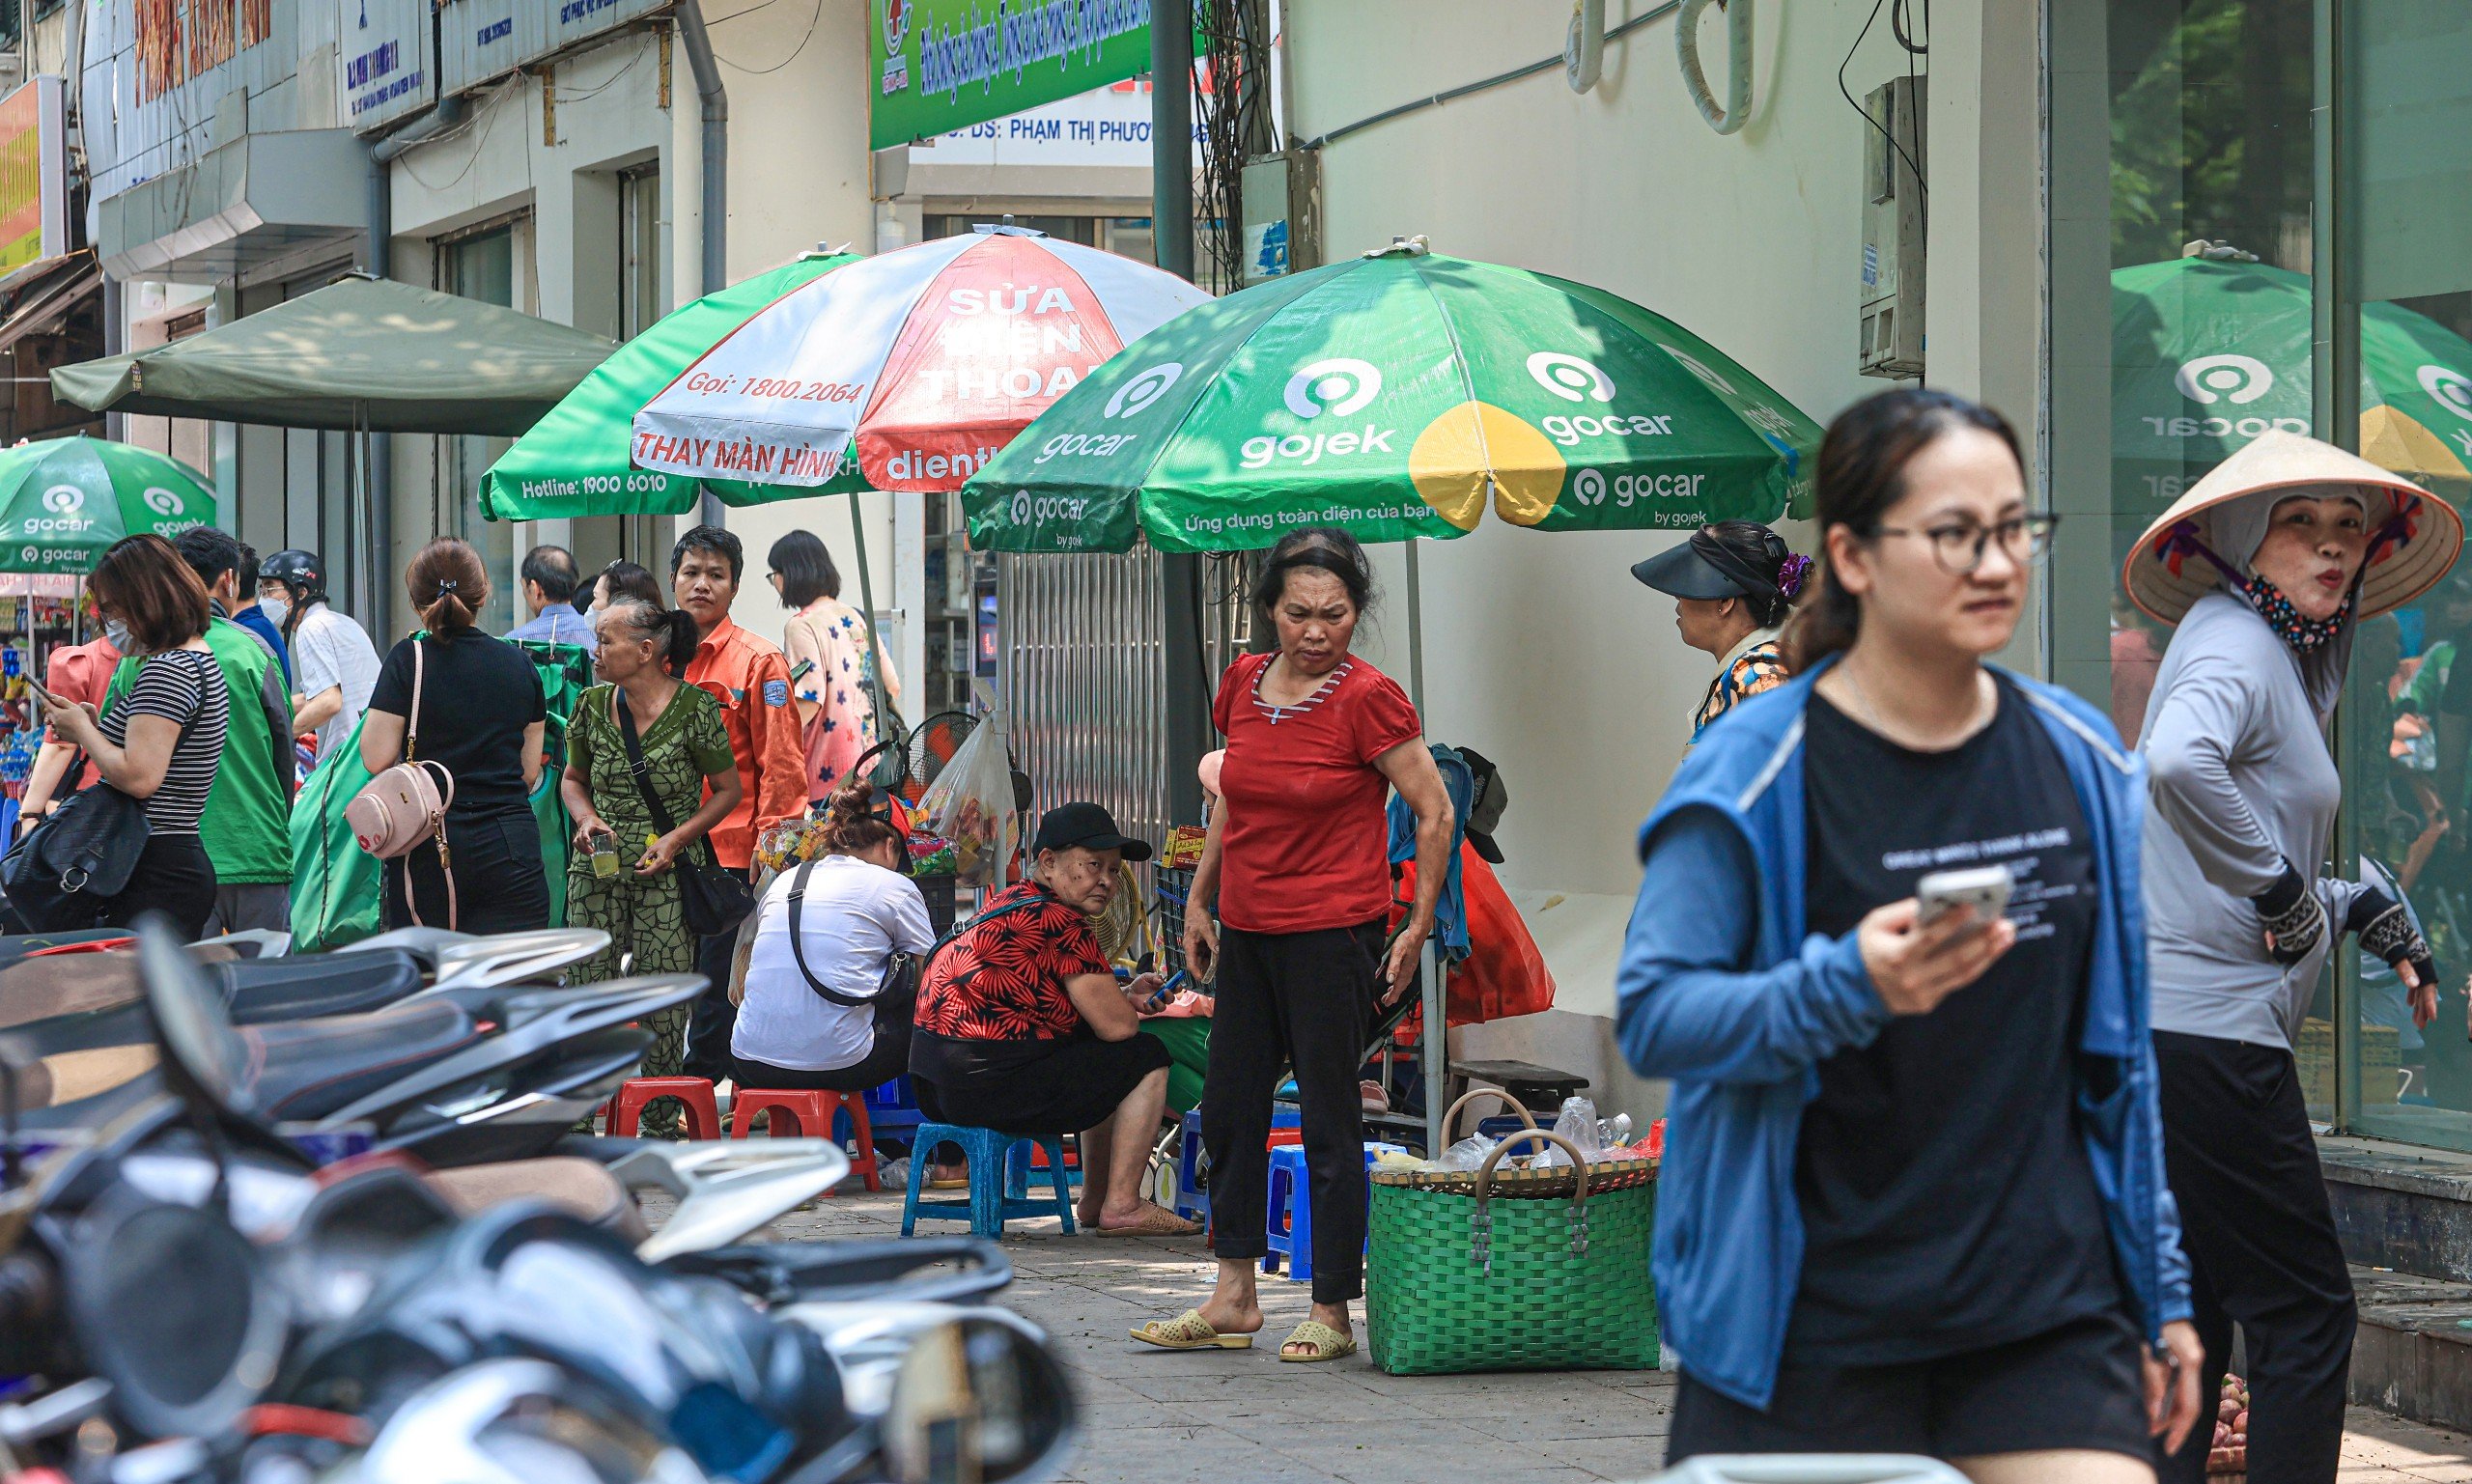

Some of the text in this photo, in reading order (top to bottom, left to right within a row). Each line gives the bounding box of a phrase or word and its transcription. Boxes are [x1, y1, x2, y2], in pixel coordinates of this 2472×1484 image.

[1011, 120, 1060, 144] PHẠM
[1068, 121, 1095, 146] THỊ
[1100, 121, 1153, 142] PHƯƠ
[948, 283, 1076, 316] SỬA
[687, 373, 865, 404] Gọi: 1800.2064
[1541, 413, 1673, 446] gocar
[637, 433, 714, 467] THAY
[715, 436, 772, 473] MÀN
[779, 441, 840, 479] HÌNH
[1034, 434, 1137, 464] gocar
[1239, 424, 1396, 468] gojek
[521, 474, 667, 500] Hotline: 1900 6010
[1615, 473, 1705, 508] gocar
[24, 518, 94, 534] gocar
[1035, 496, 1090, 528] gocar
[1185, 501, 1438, 534] Ứng dụng toàn diện của bạn
[1655, 510, 1707, 526] by gojek
[42, 548, 91, 564] gocar
[1056, 533, 1068, 548] by
